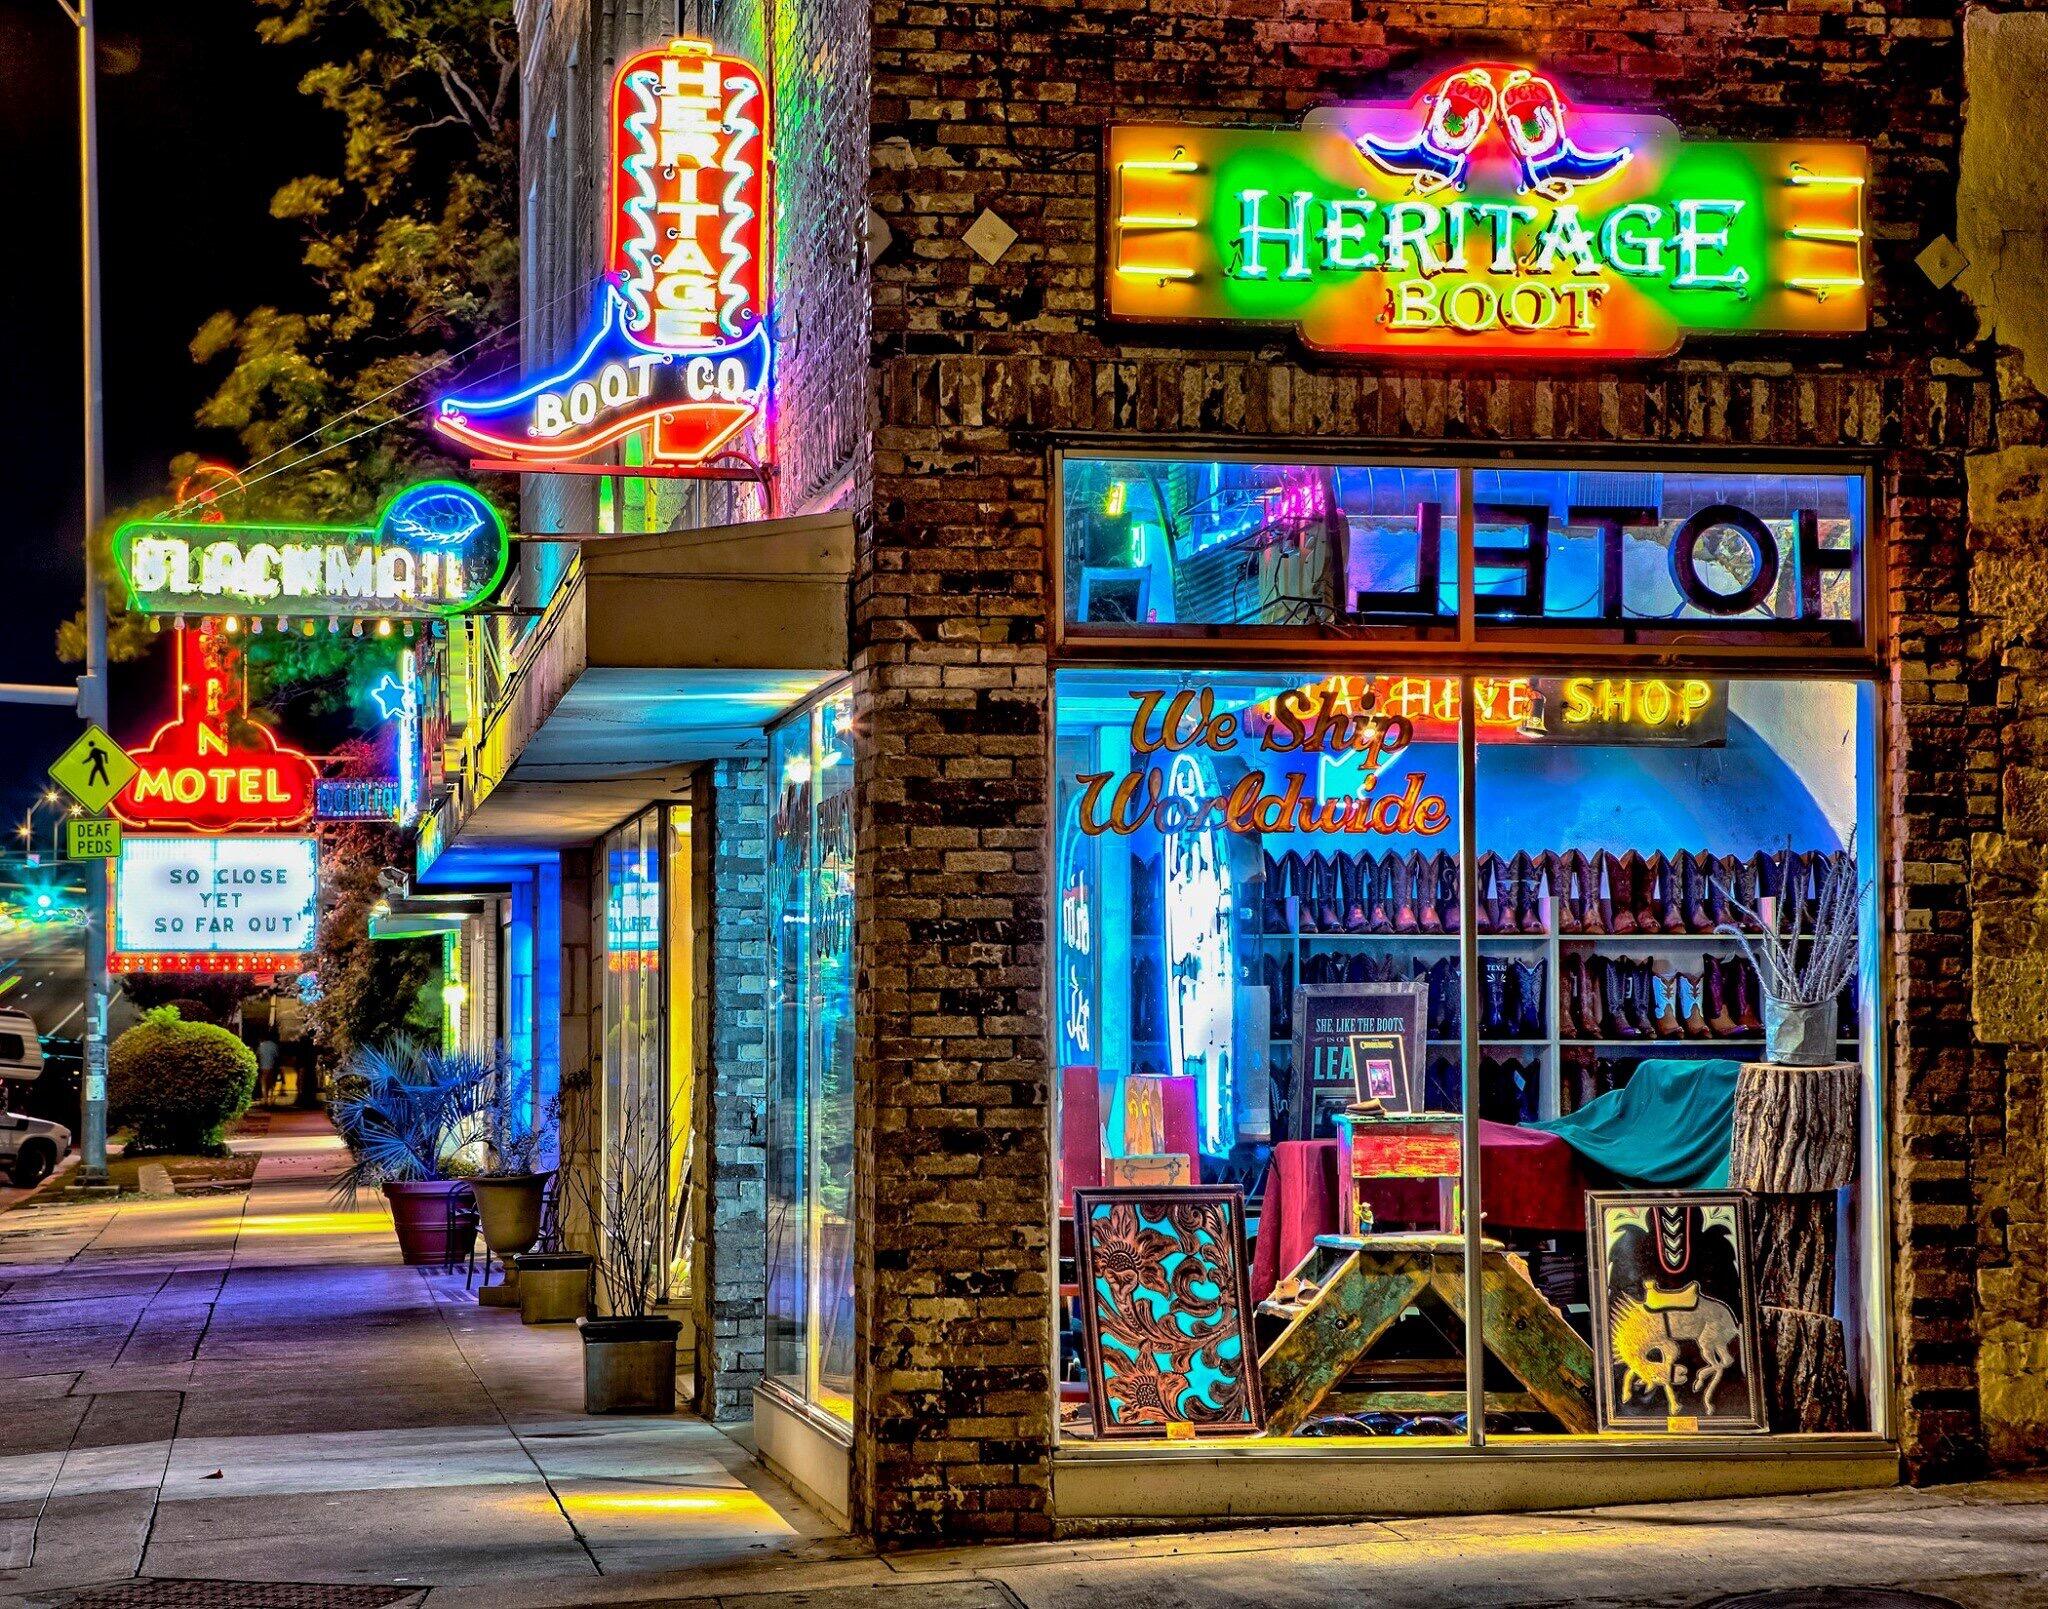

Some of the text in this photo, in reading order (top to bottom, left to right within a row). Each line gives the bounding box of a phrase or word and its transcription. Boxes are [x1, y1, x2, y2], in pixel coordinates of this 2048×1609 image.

[652, 58, 721, 347] HERITAGE
[1233, 188, 1750, 284] HERITAGE
[1390, 278, 1610, 333] BOOT
[536, 353, 662, 438] BOOT
[132, 537, 467, 600] BLACKMAIL
[1564, 677, 1712, 726] SHOP
[1128, 687, 1415, 770] We Ship
[133, 766, 291, 803] MOTEL
[1075, 768, 1450, 837] Worldwide
[77, 823, 112, 837] DEAF
[77, 840, 113, 854] PEDS
[169, 869, 287, 884] SO CLOSE
[199, 892, 243, 908] YET
[155, 917, 185, 932] SO
[195, 917, 234, 932] FAR
[1315, 1018, 1334, 1033] SHE,
[1336, 1018, 1356, 1032] LIKE
[1357, 1018, 1375, 1032] THE
